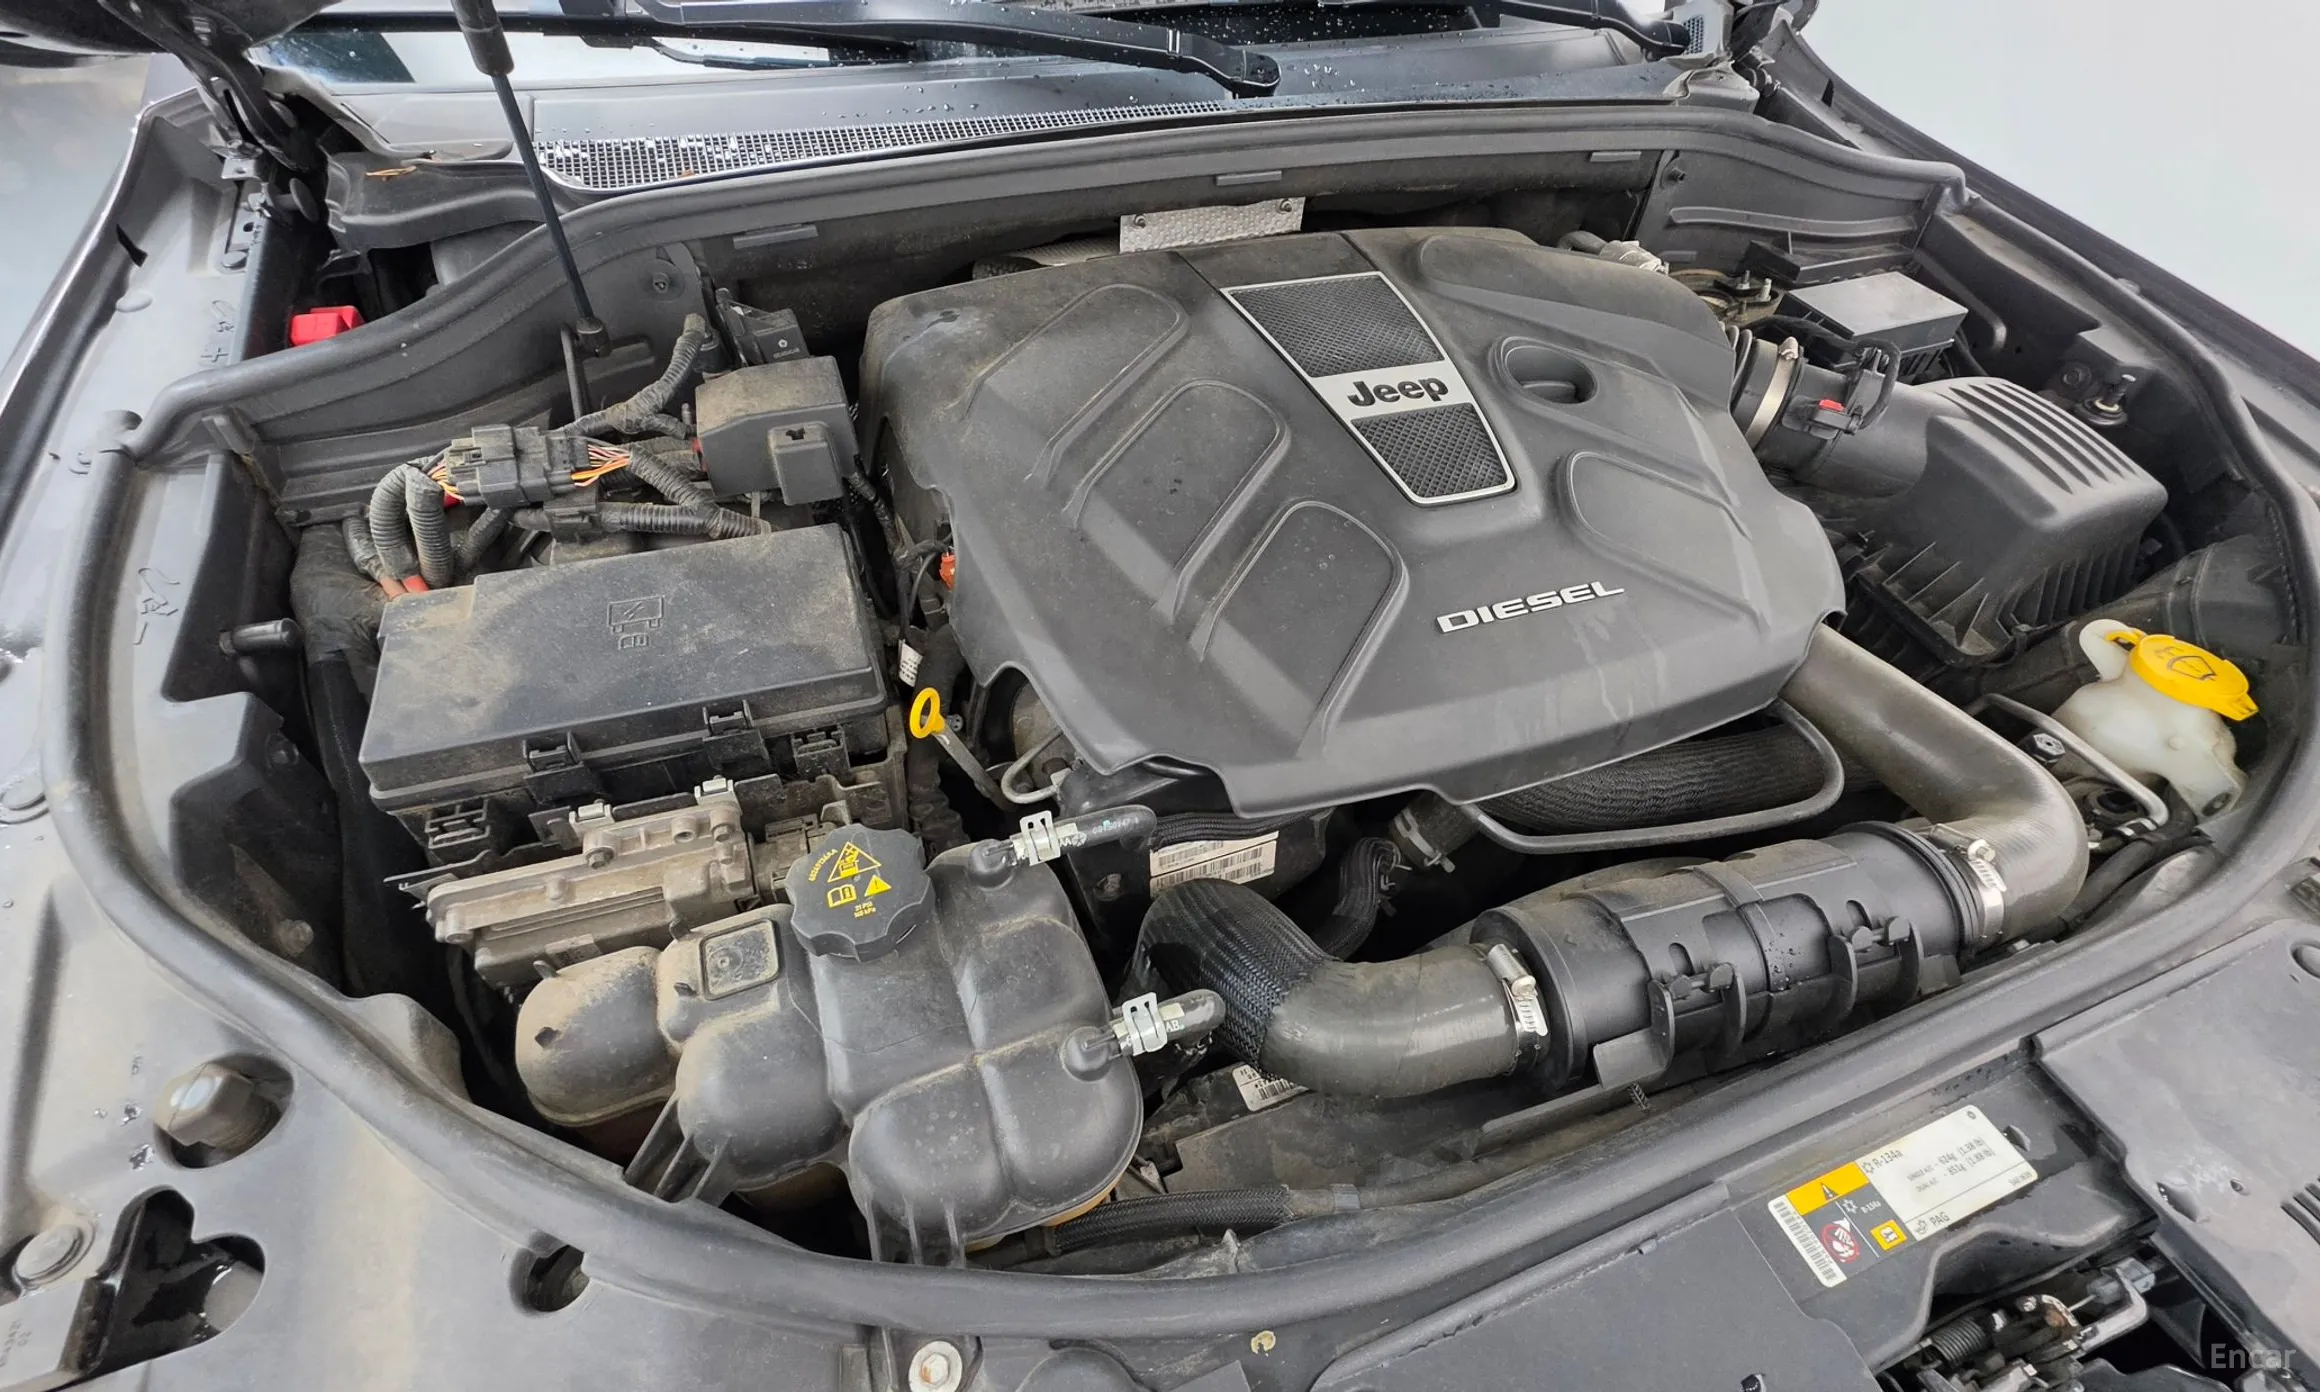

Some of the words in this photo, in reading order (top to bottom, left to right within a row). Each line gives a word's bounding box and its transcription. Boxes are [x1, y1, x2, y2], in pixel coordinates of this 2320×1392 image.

[1347, 377, 1449, 407] Jeep
[1436, 581, 1625, 633] DIESEL
[1166, 1020, 1180, 1032] AB
[1873, 1149, 1904, 1169] R-134a
[1929, 1211, 1950, 1228] PAG
